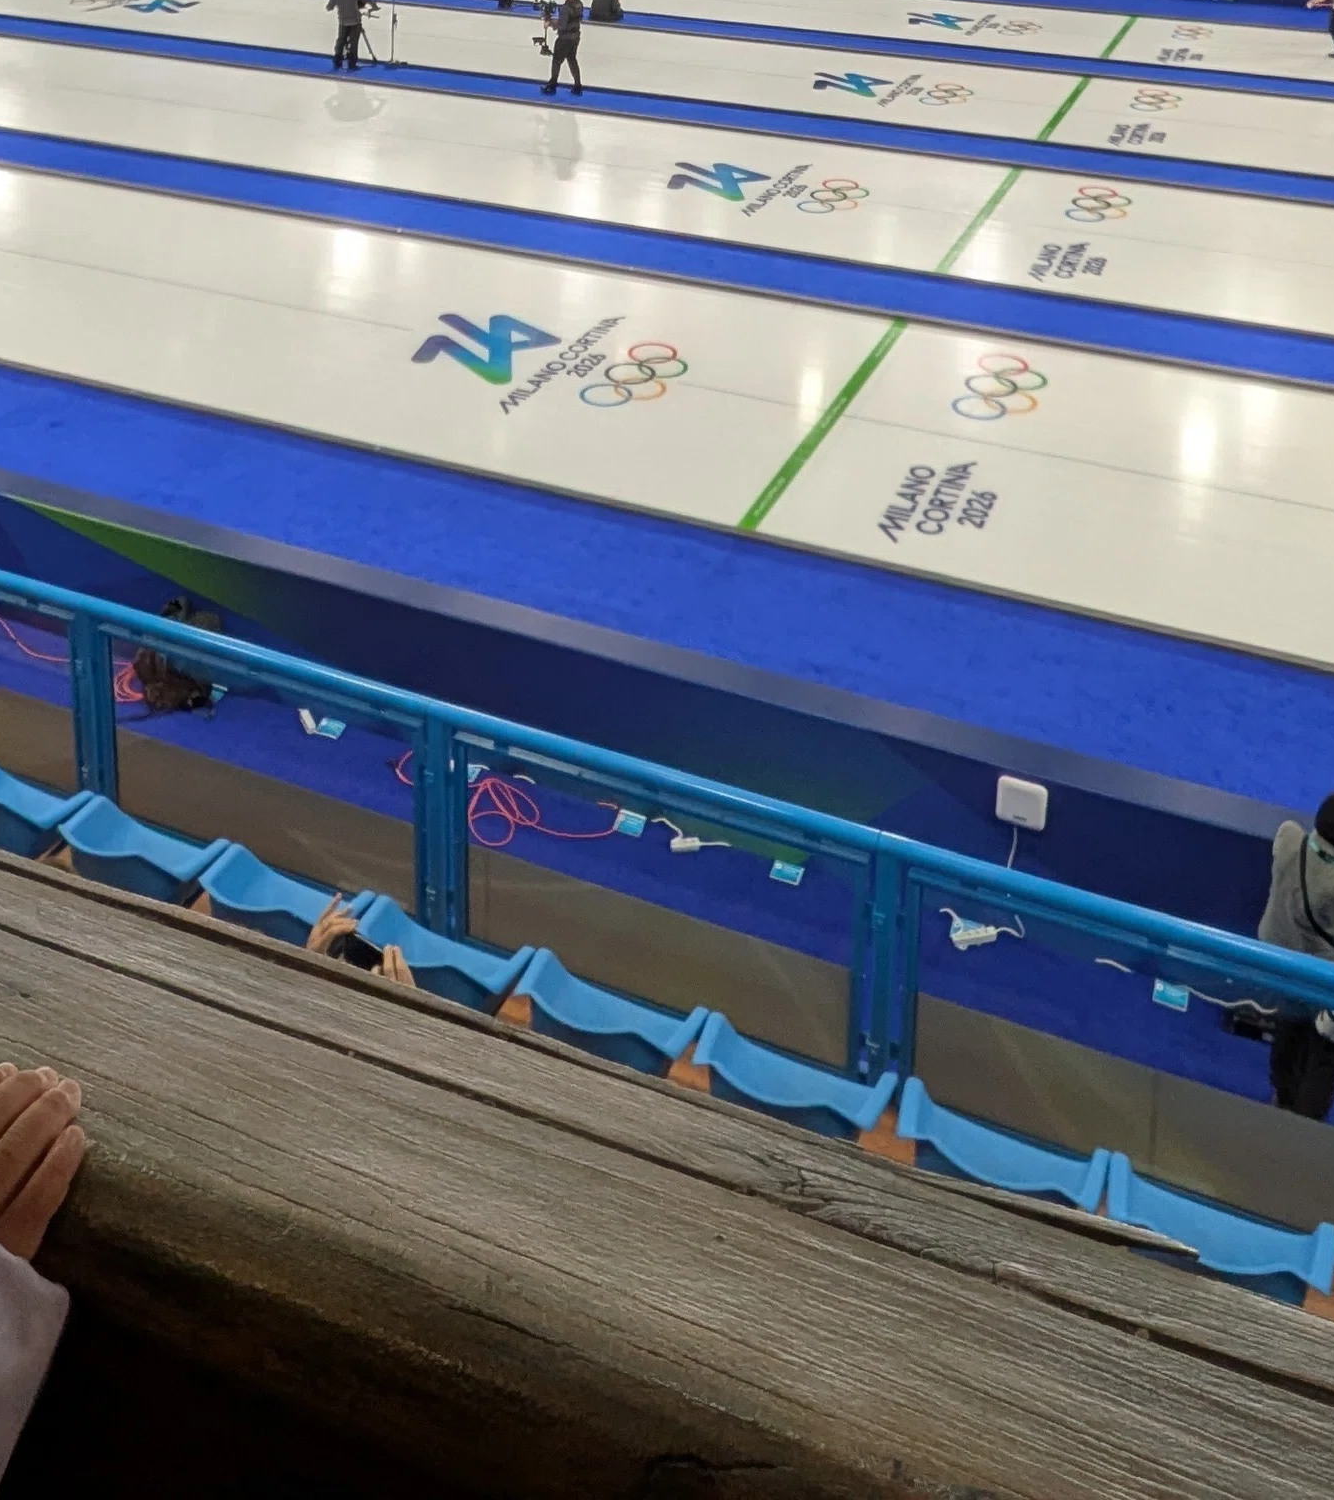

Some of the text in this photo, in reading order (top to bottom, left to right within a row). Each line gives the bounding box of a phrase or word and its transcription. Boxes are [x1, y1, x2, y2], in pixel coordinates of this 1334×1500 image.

[741, 188, 781, 217] MILANO
[1027, 244, 1063, 283] MILANO
[499, 316, 626, 415] MILANO CORTINA
[566, 353, 607, 378] 2026
[877, 465, 936, 543] MILANO
[915, 460, 977, 536] CORTINA
[956, 488, 998, 529] 2026
